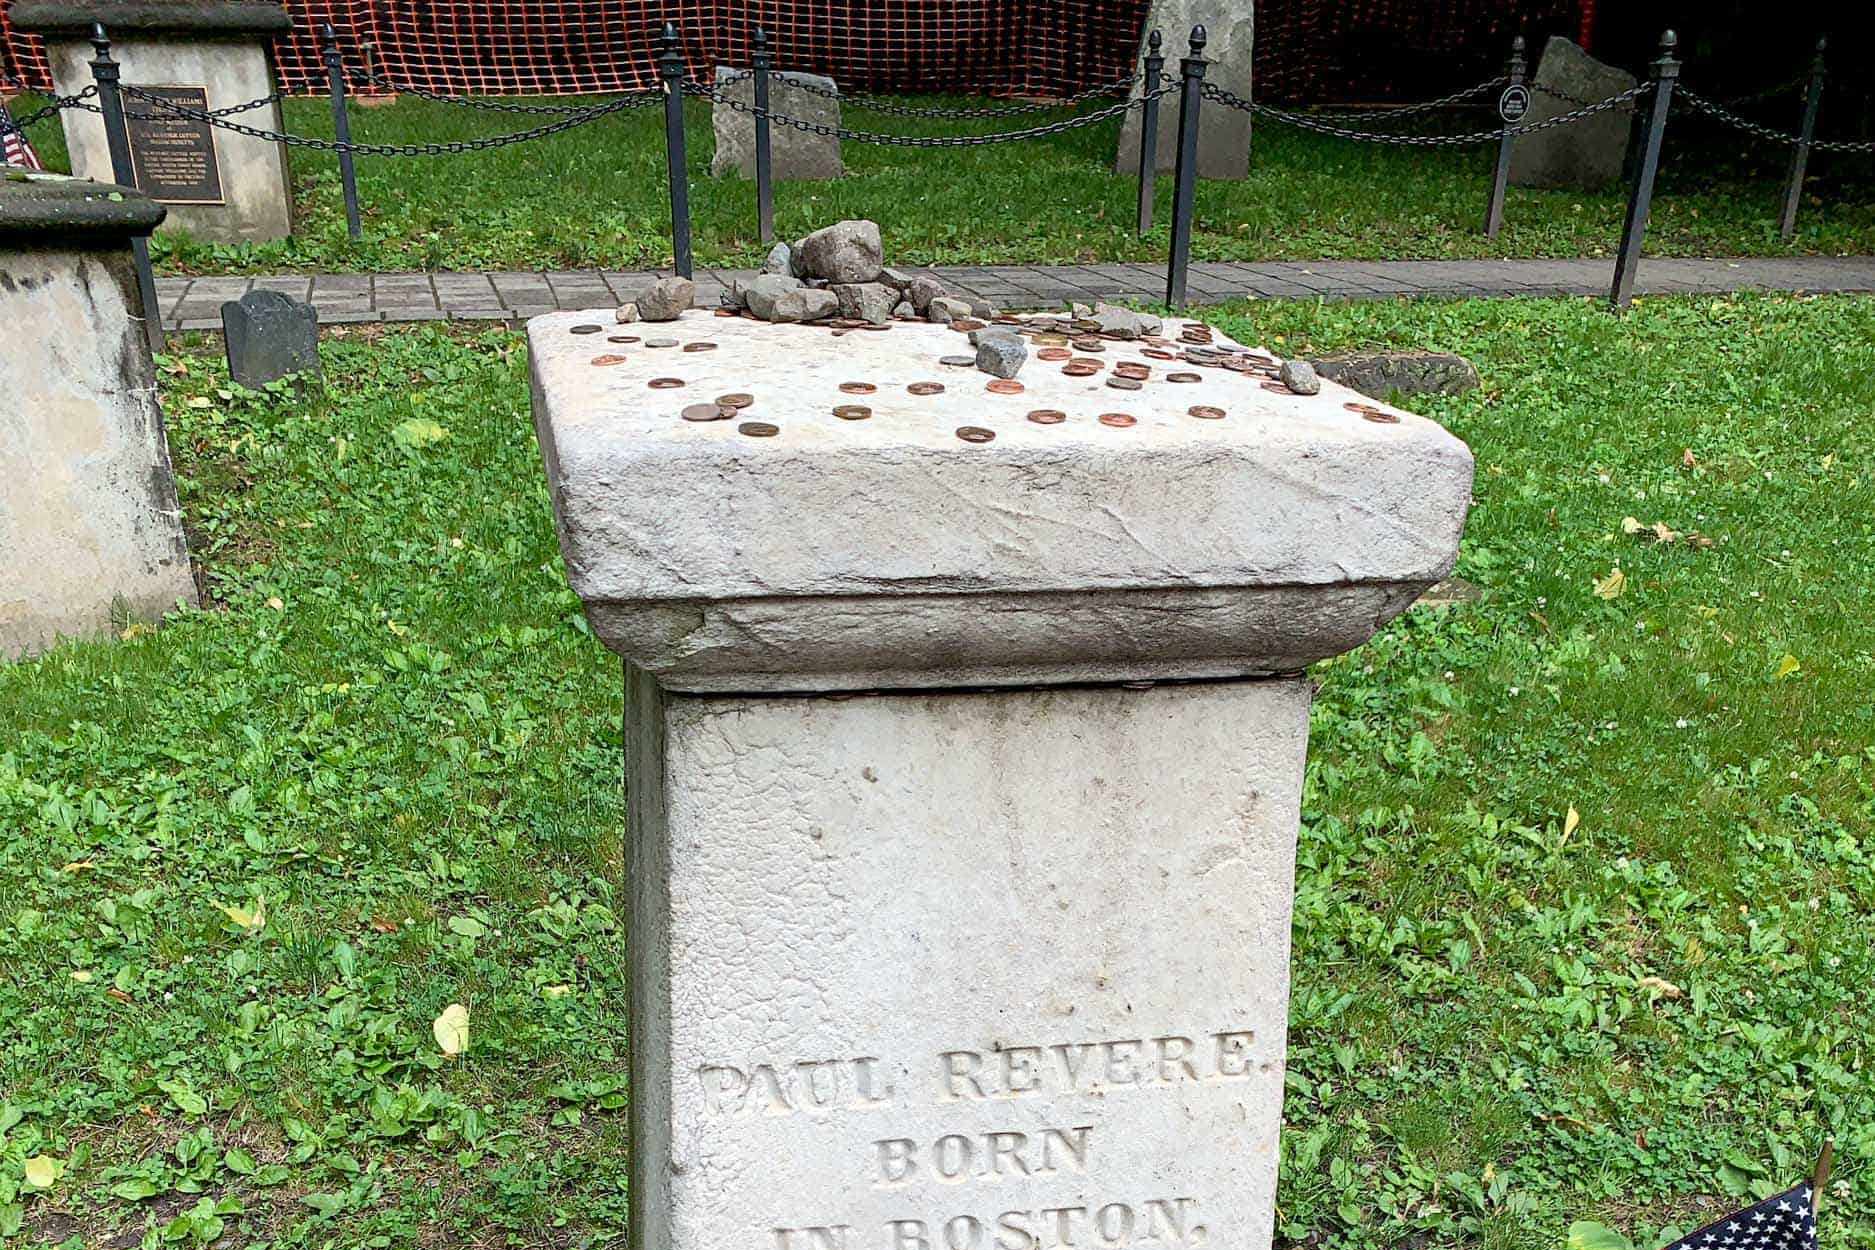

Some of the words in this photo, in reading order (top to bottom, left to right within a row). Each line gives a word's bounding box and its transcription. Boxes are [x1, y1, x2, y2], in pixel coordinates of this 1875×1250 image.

[700, 1056, 894, 1115] PAUL
[937, 1031, 1270, 1102] REVERE.
[873, 1126, 1094, 1186] BORN
